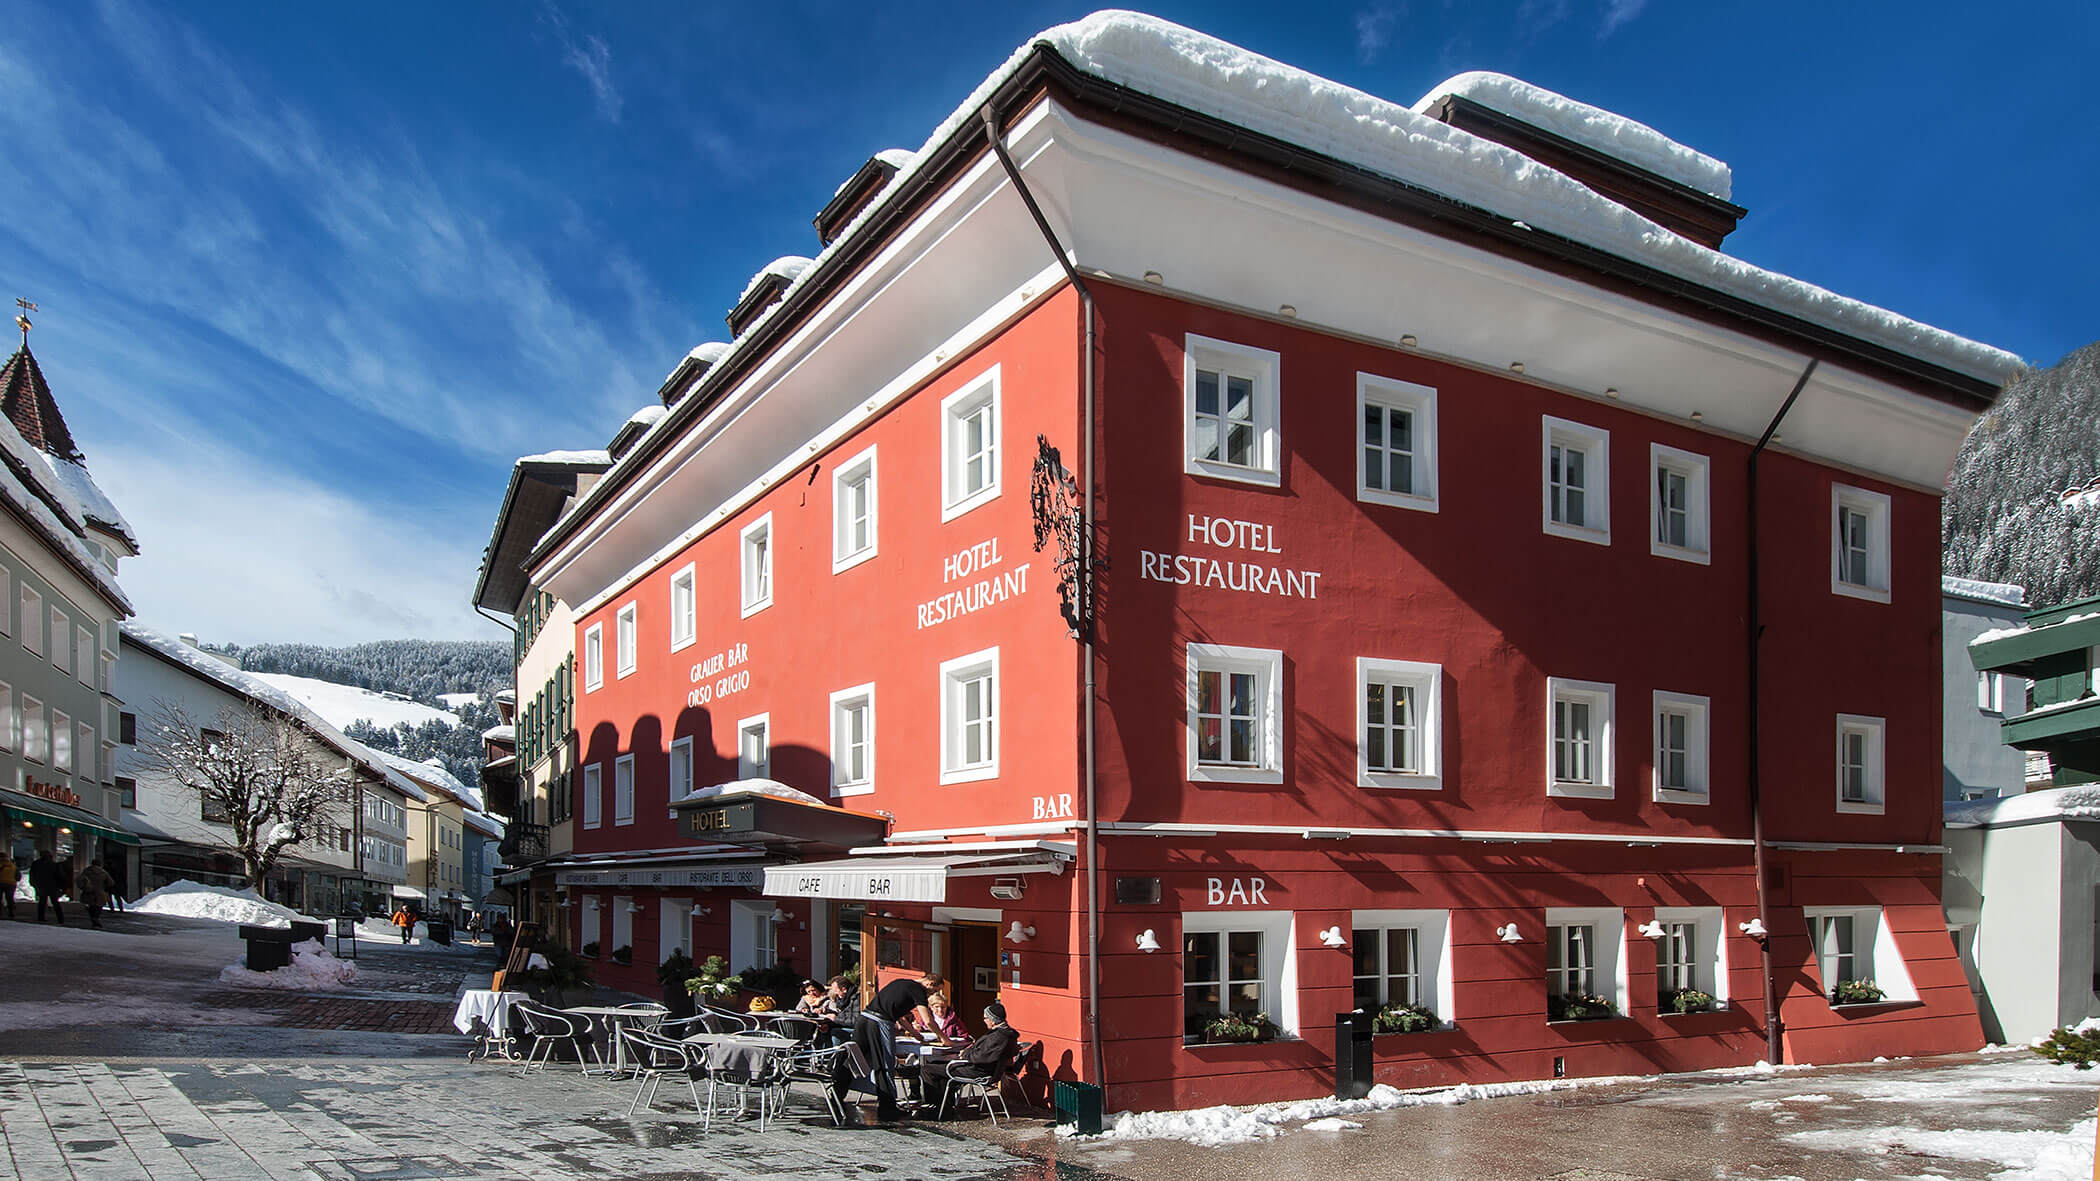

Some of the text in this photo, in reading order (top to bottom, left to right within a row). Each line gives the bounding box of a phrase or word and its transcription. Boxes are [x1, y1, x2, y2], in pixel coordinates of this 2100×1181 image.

[1188, 513, 1282, 554] HOTEL
[943, 536, 1002, 584] HOTEL
[1140, 550, 1321, 600] RESTAURANT
[917, 563, 1031, 630] RESTAURANT
[690, 653, 725, 683] GRAUER
[687, 670, 750, 708] ORSO GRIGIO
[691, 809, 730, 832] HOTEL
[1031, 793, 1074, 820] BAR
[799, 878, 891, 895] CAFE BAR
[1207, 877, 1270, 906] BAR
